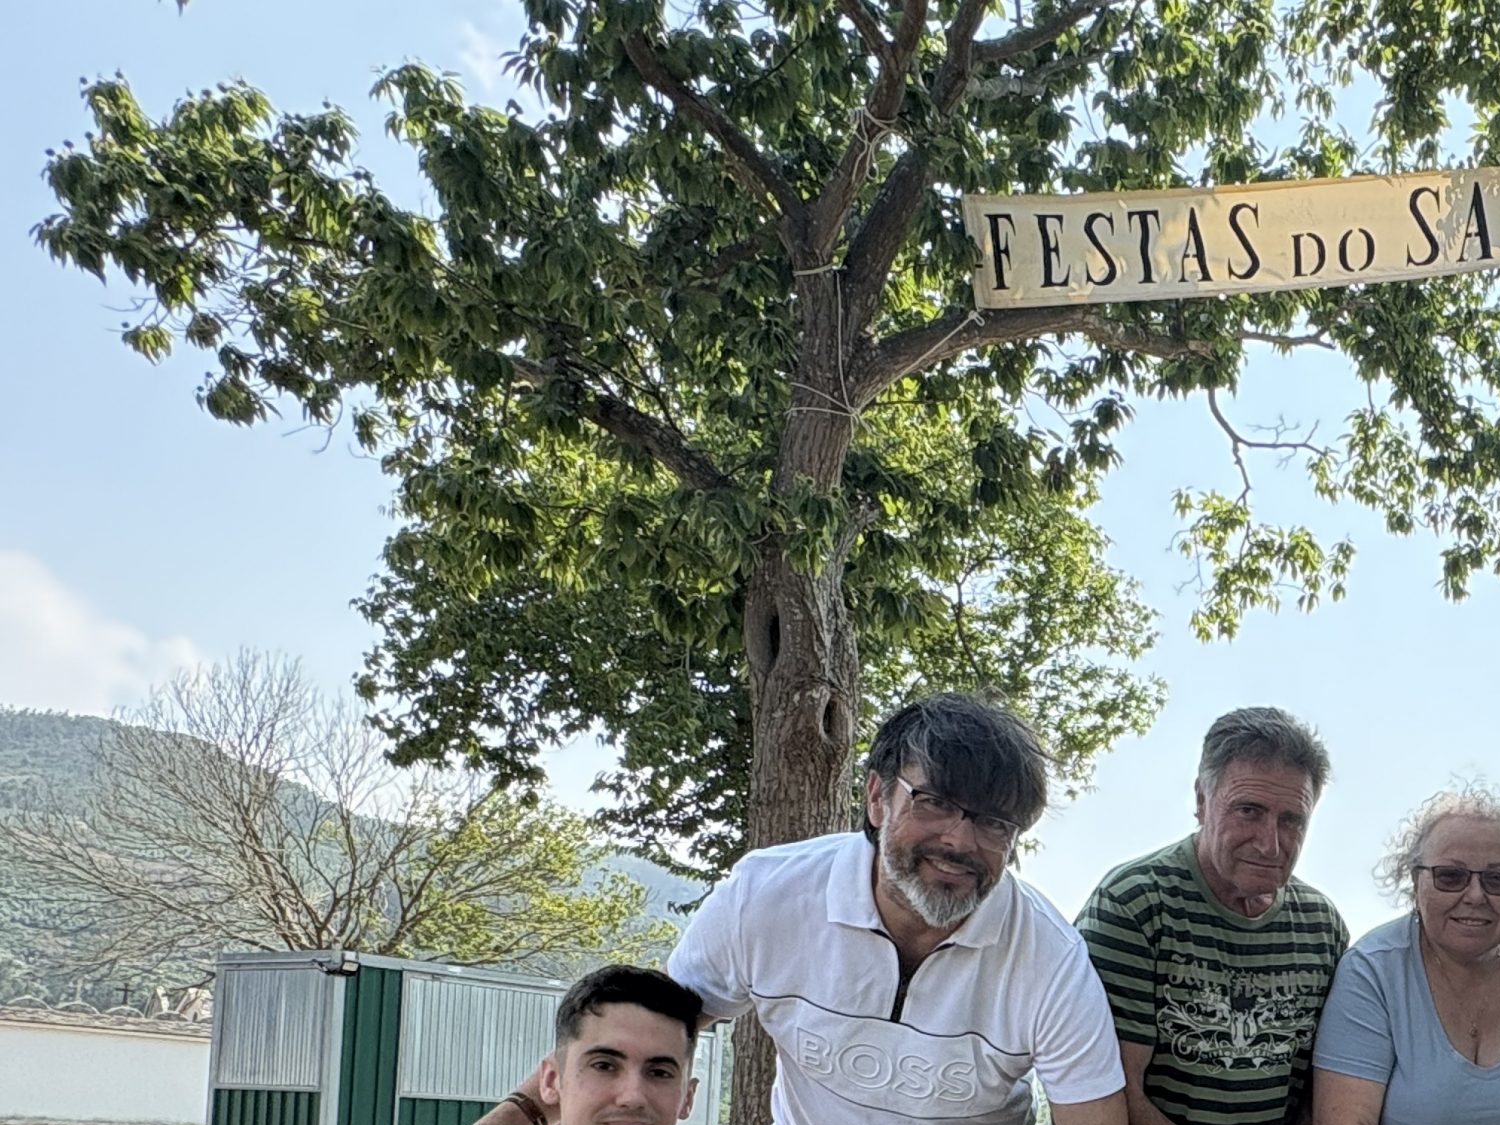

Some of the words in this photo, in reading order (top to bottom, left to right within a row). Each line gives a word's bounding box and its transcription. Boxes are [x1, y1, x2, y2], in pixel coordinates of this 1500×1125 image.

[984, 203, 1260, 291] FESTAS
[1293, 228, 1376, 278] DO
[796, 1027, 976, 1102] BOSS
